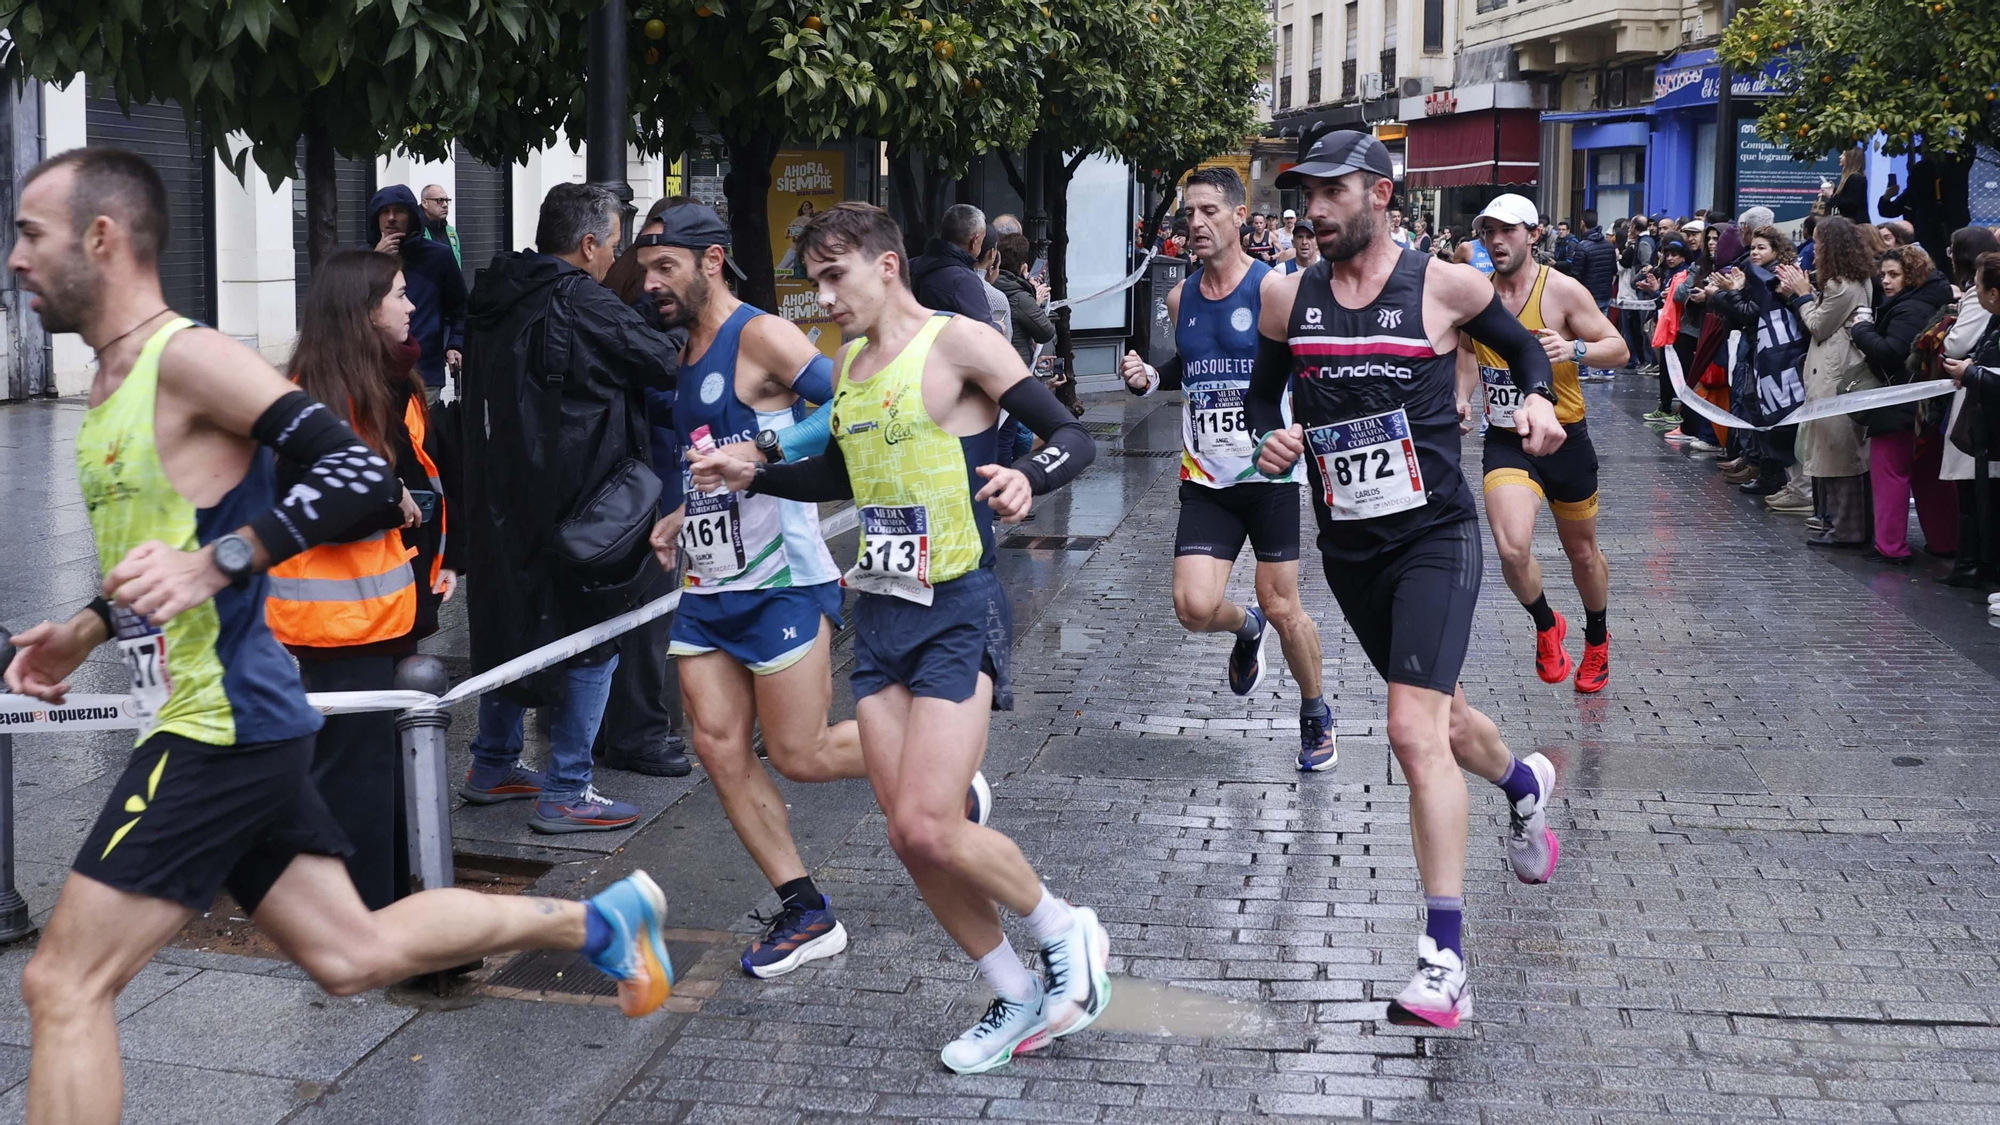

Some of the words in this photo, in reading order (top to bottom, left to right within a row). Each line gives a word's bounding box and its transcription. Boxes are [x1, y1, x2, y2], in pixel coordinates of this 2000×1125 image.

[784, 161, 824, 178] AHORA
[777, 174, 832, 192] SIEMPRE
[1197, 410, 1248, 434] 1158
[1348, 418, 1383, 433] MEDIA
[1334, 448, 1395, 487] 872
[1355, 488, 1381, 499] CARLOS
[859, 540, 916, 572] 513
